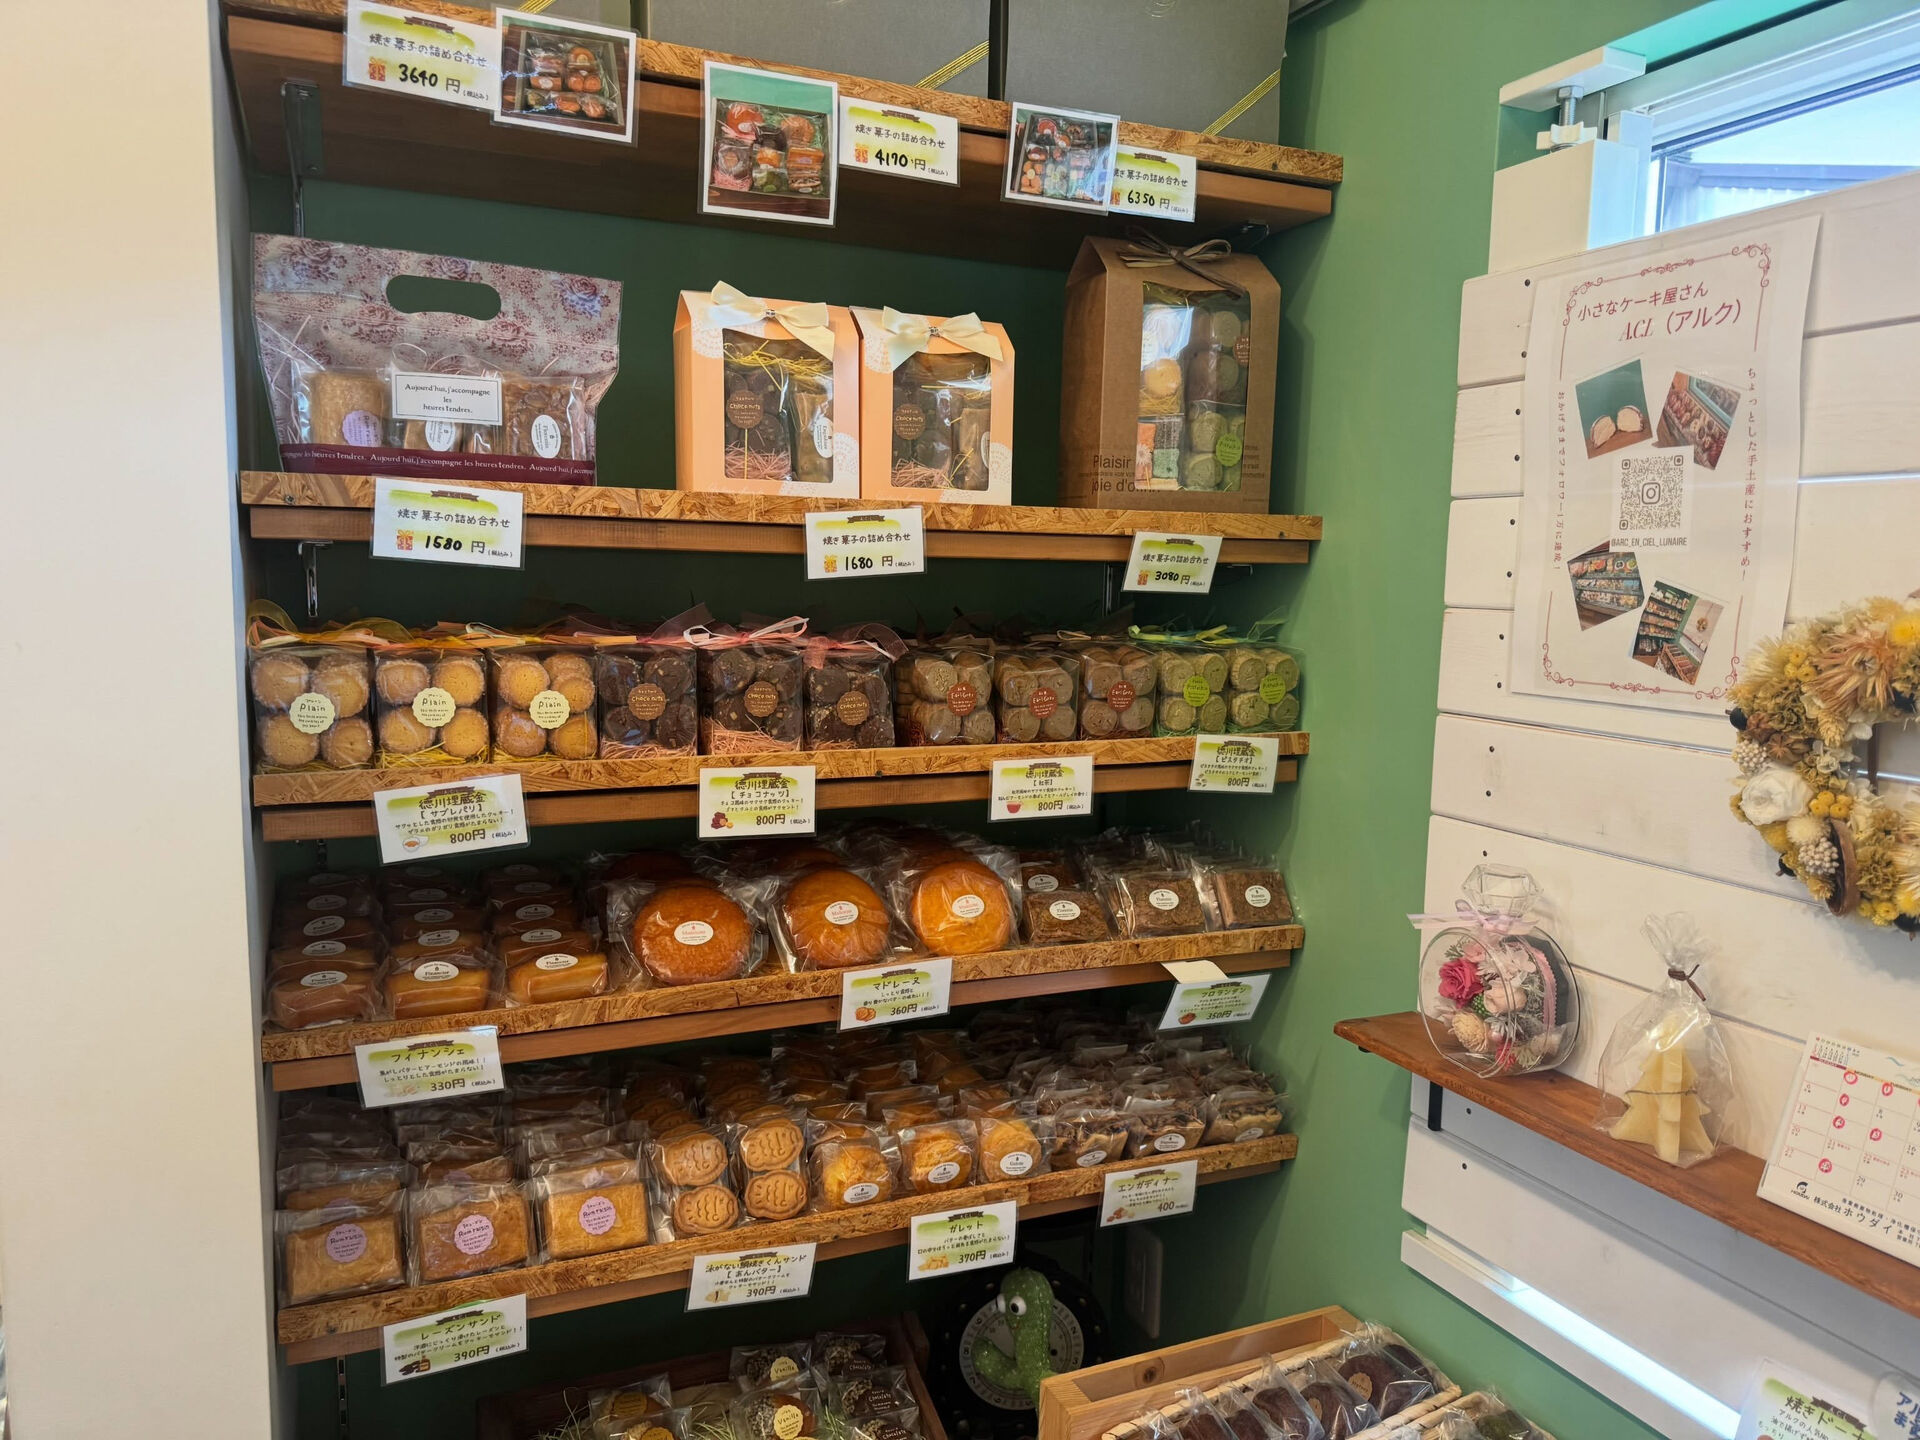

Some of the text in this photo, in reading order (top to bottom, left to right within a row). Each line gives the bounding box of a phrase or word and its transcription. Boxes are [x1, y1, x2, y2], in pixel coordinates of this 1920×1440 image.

[369, 33, 489, 68] 焼き菓子の詰め合わせ
[855, 123, 946, 149] 焼き菓子の詰め合わせ
[874, 148, 908, 168] 4170
[1127, 189, 1156, 207] 6350
[1577, 281, 1708, 321] 小さなケーキ屋さん
[1666, 299, 1741, 334] （アルク）
[1093, 455, 1132, 469] Plaisir
[397, 508, 510, 528] 焼き菓子の詰め合わせ
[425, 535, 463, 552] 1580
[822, 532, 911, 546] 焼き菓子の詰め合わせ
[845, 556, 874, 571] 1680
[1142, 554, 1209, 565] 焼き菓子の詰め合わせ
[1154, 570, 1180, 582] 3080
[300, 703, 326, 712] Plain
[422, 698, 447, 706] Plain
[538, 701, 562, 710] Plain
[418, 792, 487, 810] 徳川埋蔵金
[1038, 800, 1064, 812] 800円
[756, 813, 786, 826] 800円
[450, 829, 486, 845] 800円
[873, 976, 921, 991] マドレーヌ
[890, 1003, 918, 1016] 360円
[1206, 1010, 1233, 1020] 350円
[391, 1048, 465, 1063] フィナンシェ
[431, 1078, 466, 1092] 330円
[1813, 1196, 1842, 1214] 株式会社
[1843, 1208, 1893, 1235] ホウダイ
[949, 1220, 984, 1234] ガレット
[958, 1249, 987, 1264] 370円
[746, 1285, 777, 1298] 390円
[420, 1314, 502, 1341] レーズンサンド
[454, 1345, 490, 1363] 390円
